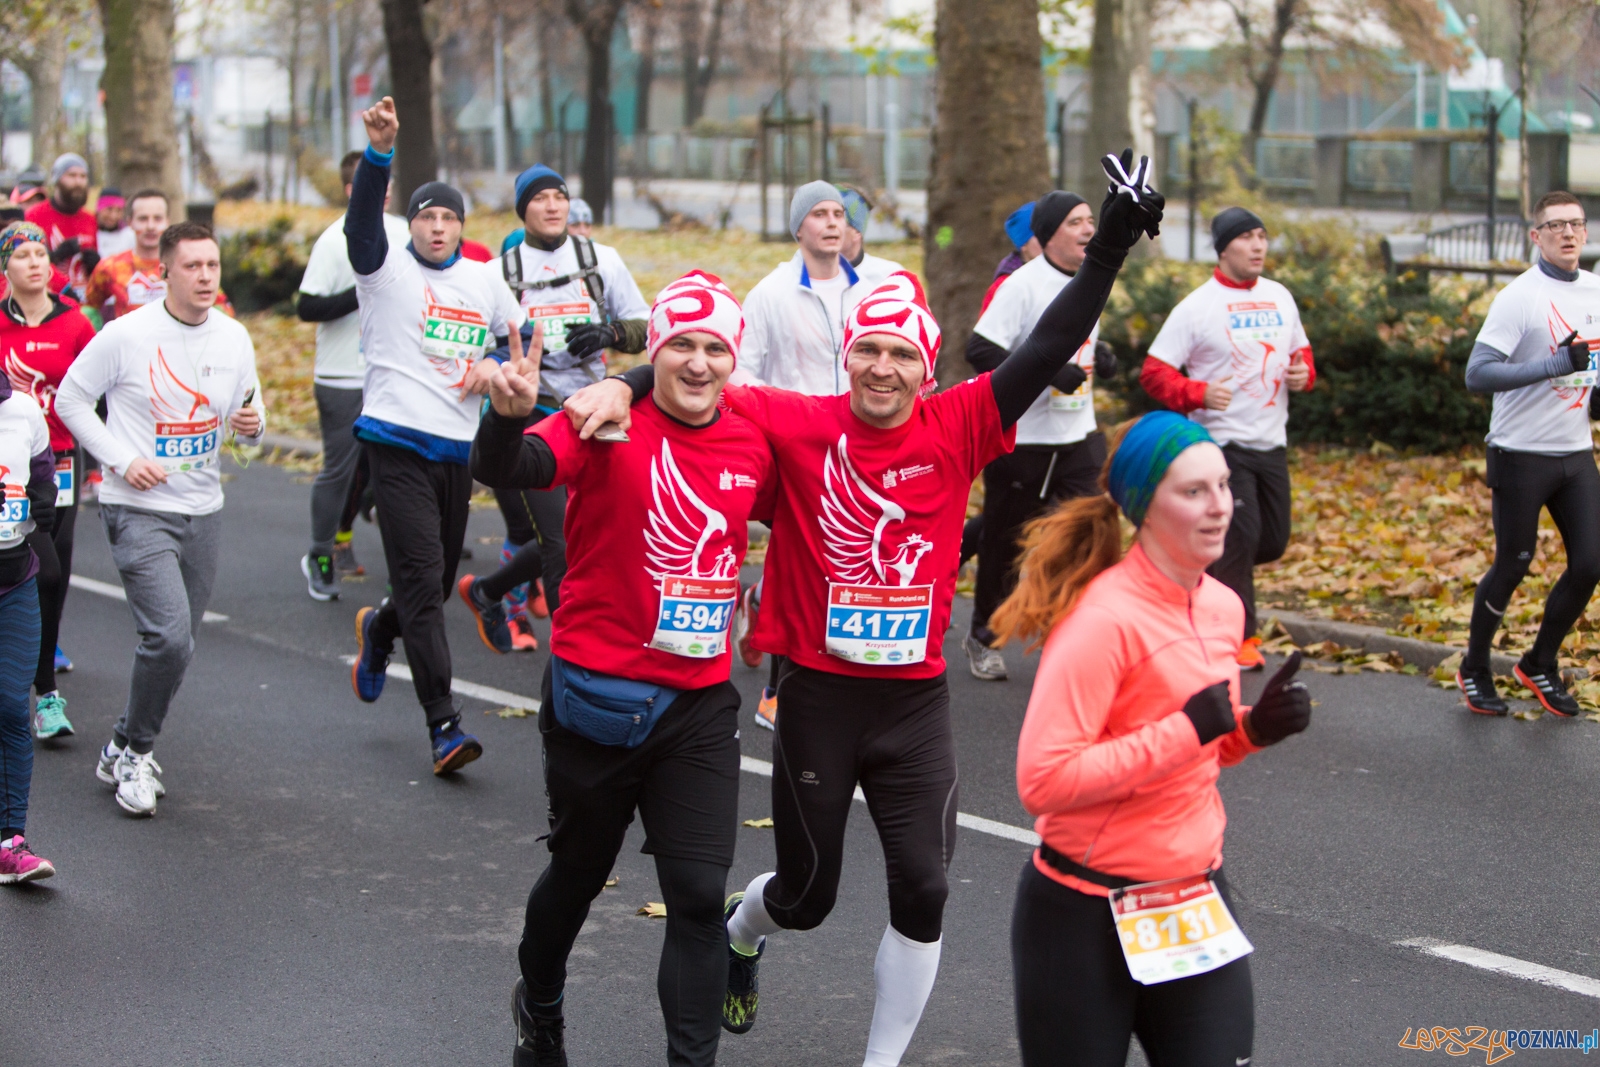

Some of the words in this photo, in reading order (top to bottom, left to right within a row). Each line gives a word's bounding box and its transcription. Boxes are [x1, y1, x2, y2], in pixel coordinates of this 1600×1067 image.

[1236, 311, 1279, 328] 7705
[432, 321, 481, 345] 4761
[165, 433, 214, 457] 6613
[662, 610, 671, 620] E
[672, 604, 731, 631] 5941
[831, 618, 840, 628] E
[842, 611, 922, 638] 4177
[1134, 904, 1218, 950] 8131
